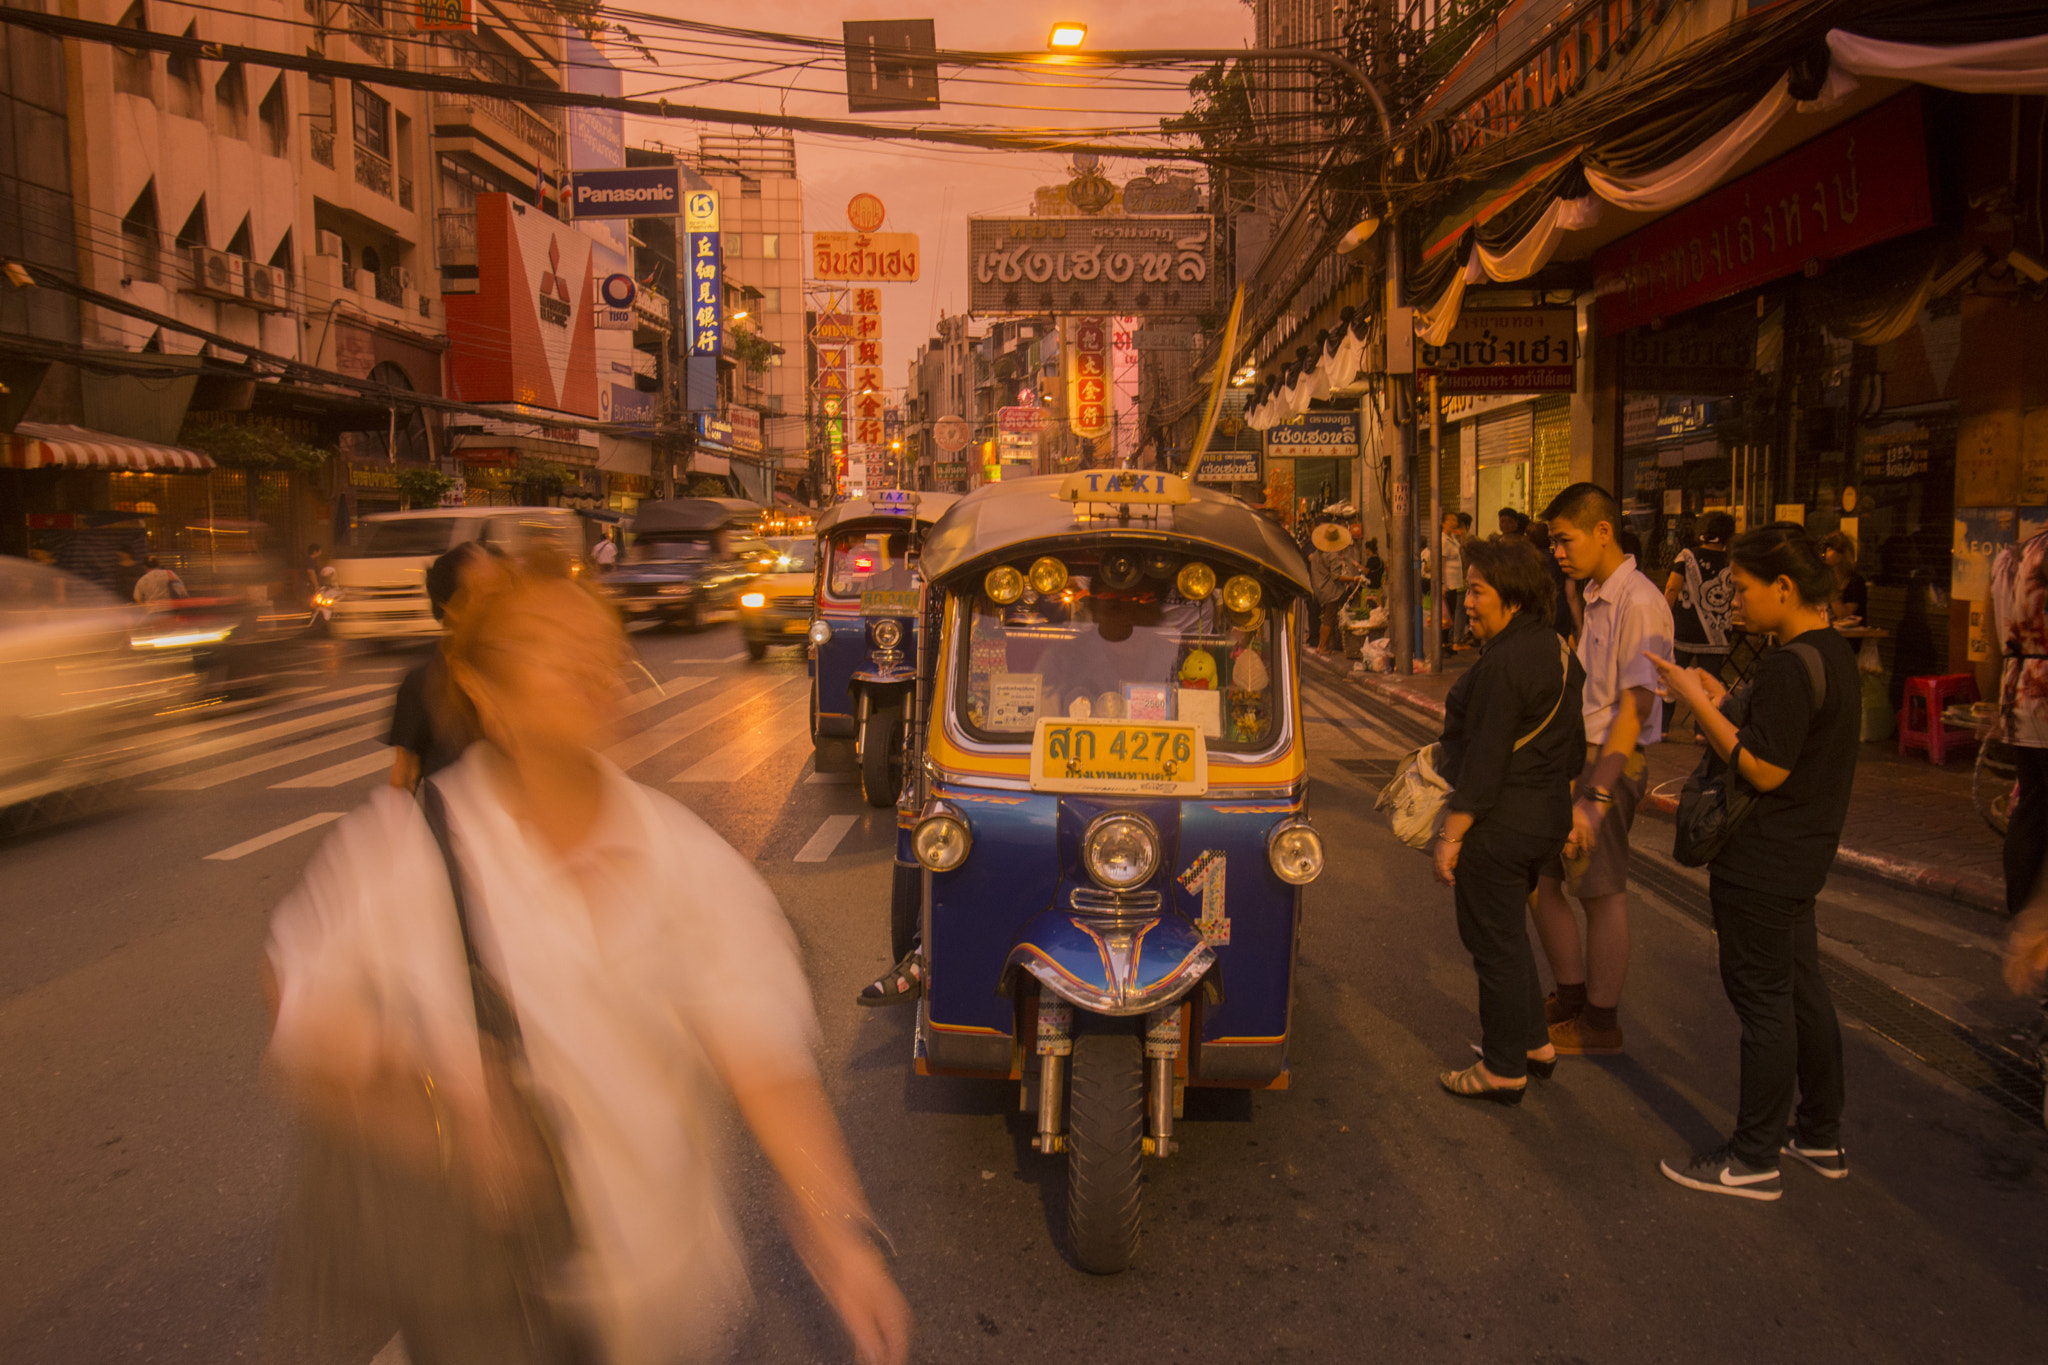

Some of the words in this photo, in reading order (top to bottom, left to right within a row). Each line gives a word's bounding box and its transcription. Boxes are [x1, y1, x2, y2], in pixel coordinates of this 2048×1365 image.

[578, 183, 674, 203] Panasonic
[977, 233, 1207, 283] เซ่งเฮงหลี
[609, 312, 629, 322] TISCO
[1271, 426, 1356, 444] เซ่งเฮงหลี
[1085, 473, 1165, 495] TAXI
[879, 492, 911, 501] TAXI
[1049, 727, 1095, 761] สก
[1110, 731, 1190, 763] 4276
